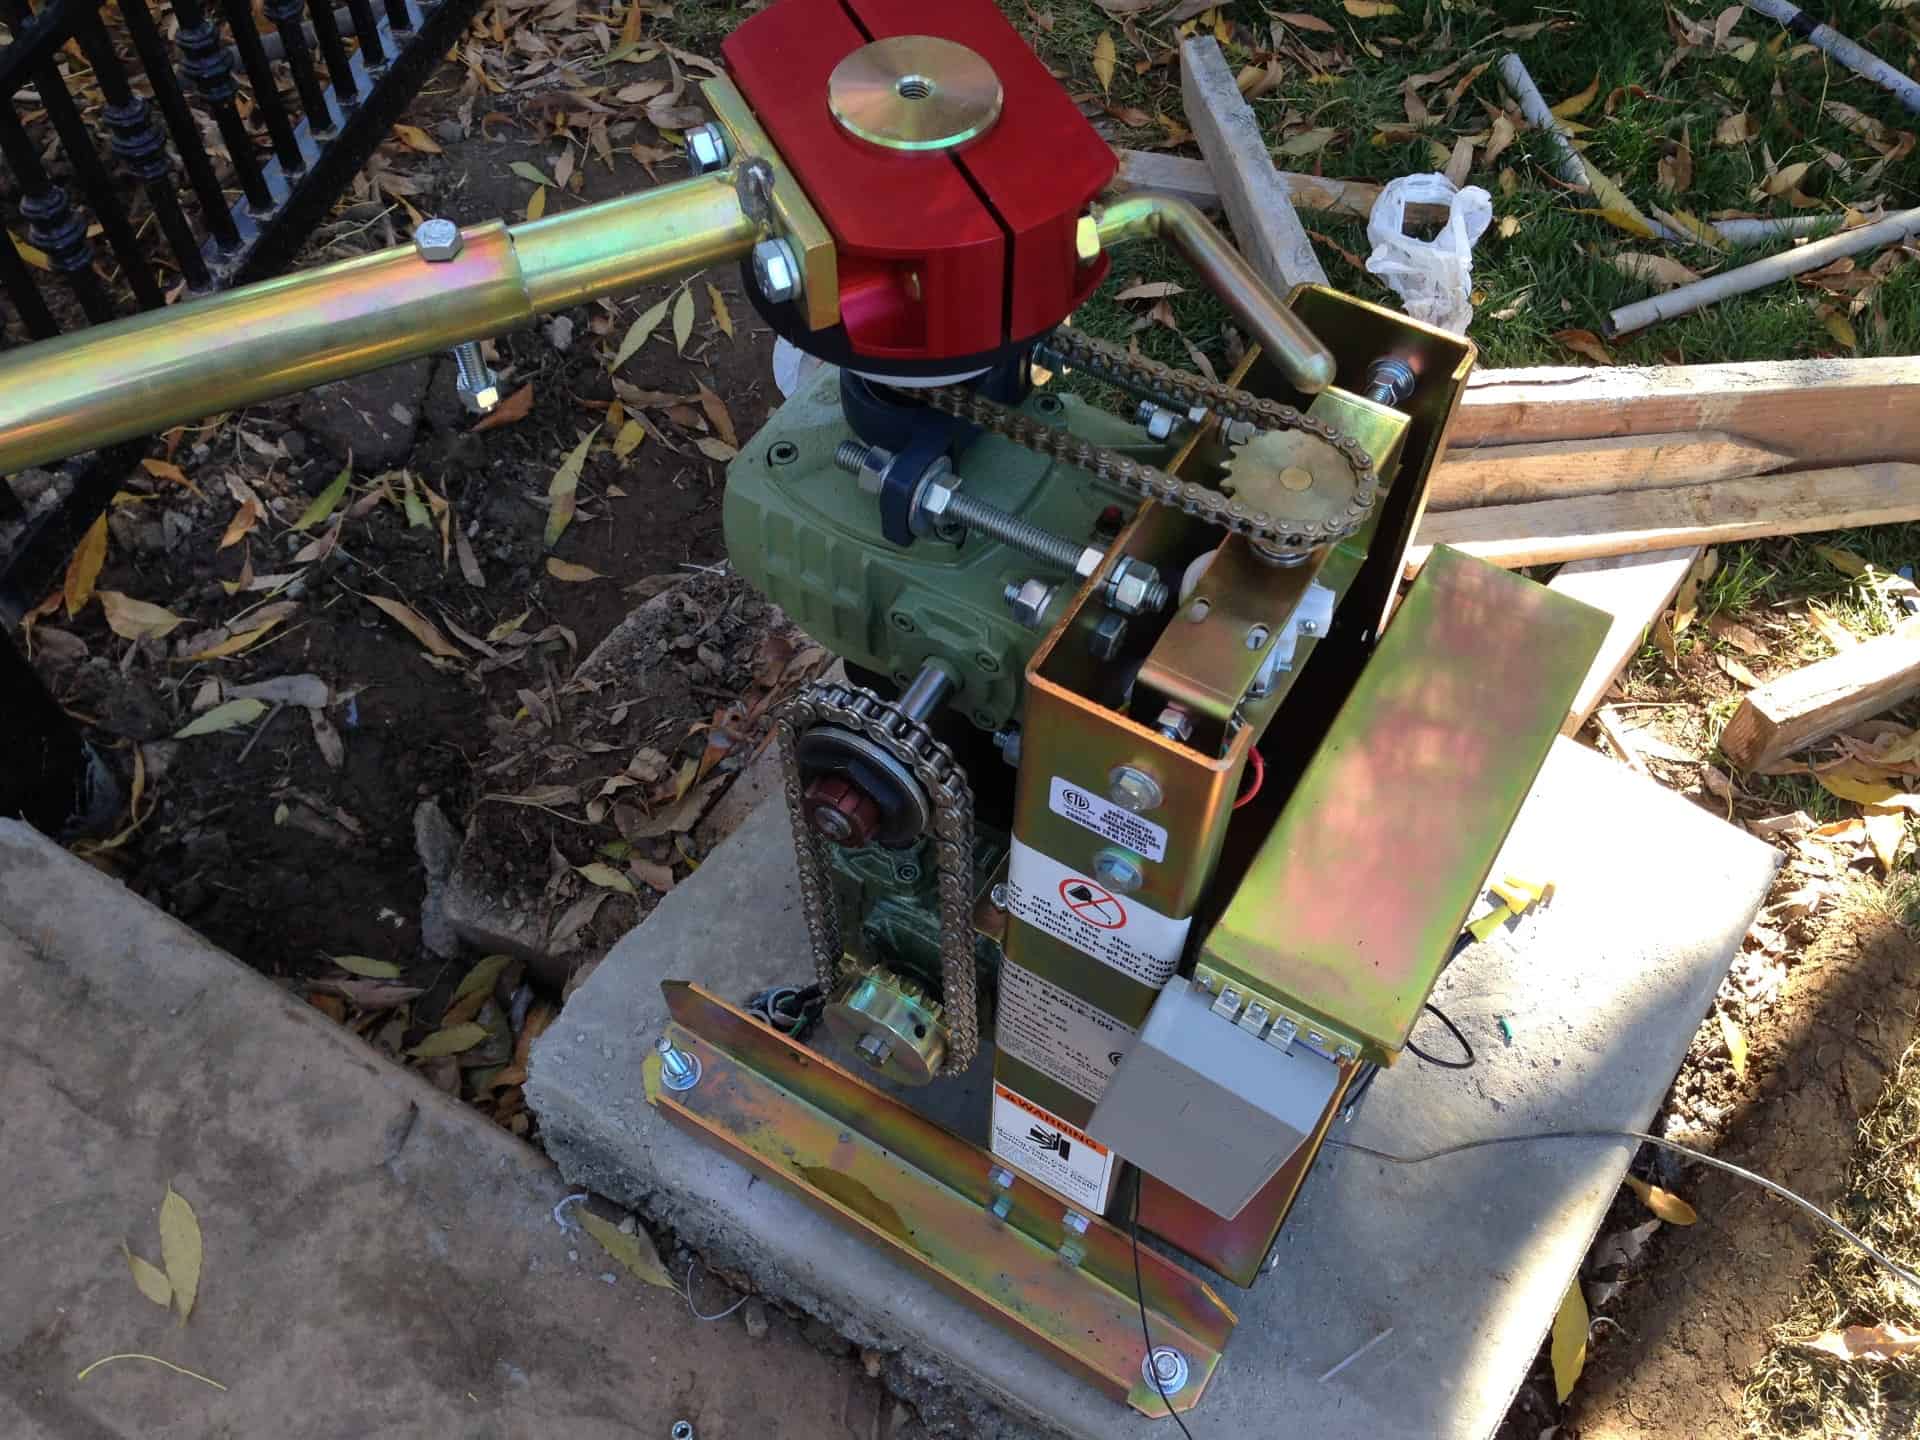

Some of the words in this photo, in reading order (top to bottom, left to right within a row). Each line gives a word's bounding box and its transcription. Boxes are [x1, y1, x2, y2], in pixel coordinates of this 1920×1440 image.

[1030, 900, 1070, 925] clutch,
[1078, 925, 1099, 939] the
[1107, 941, 1143, 962] chain
[1031, 894, 1051, 907] not
[1060, 909, 1102, 933] grease
[1109, 935, 1132, 949] the
[1034, 916, 1097, 952] lubrication
[1043, 915, 1072, 932] must
[1074, 931, 1090, 941] be
[1091, 939, 1119, 957] kept
[1119, 955, 1142, 969] dry
[1041, 987, 1114, 1031] EAGLE-100
[1020, 1099, 1097, 1151] WARNING
